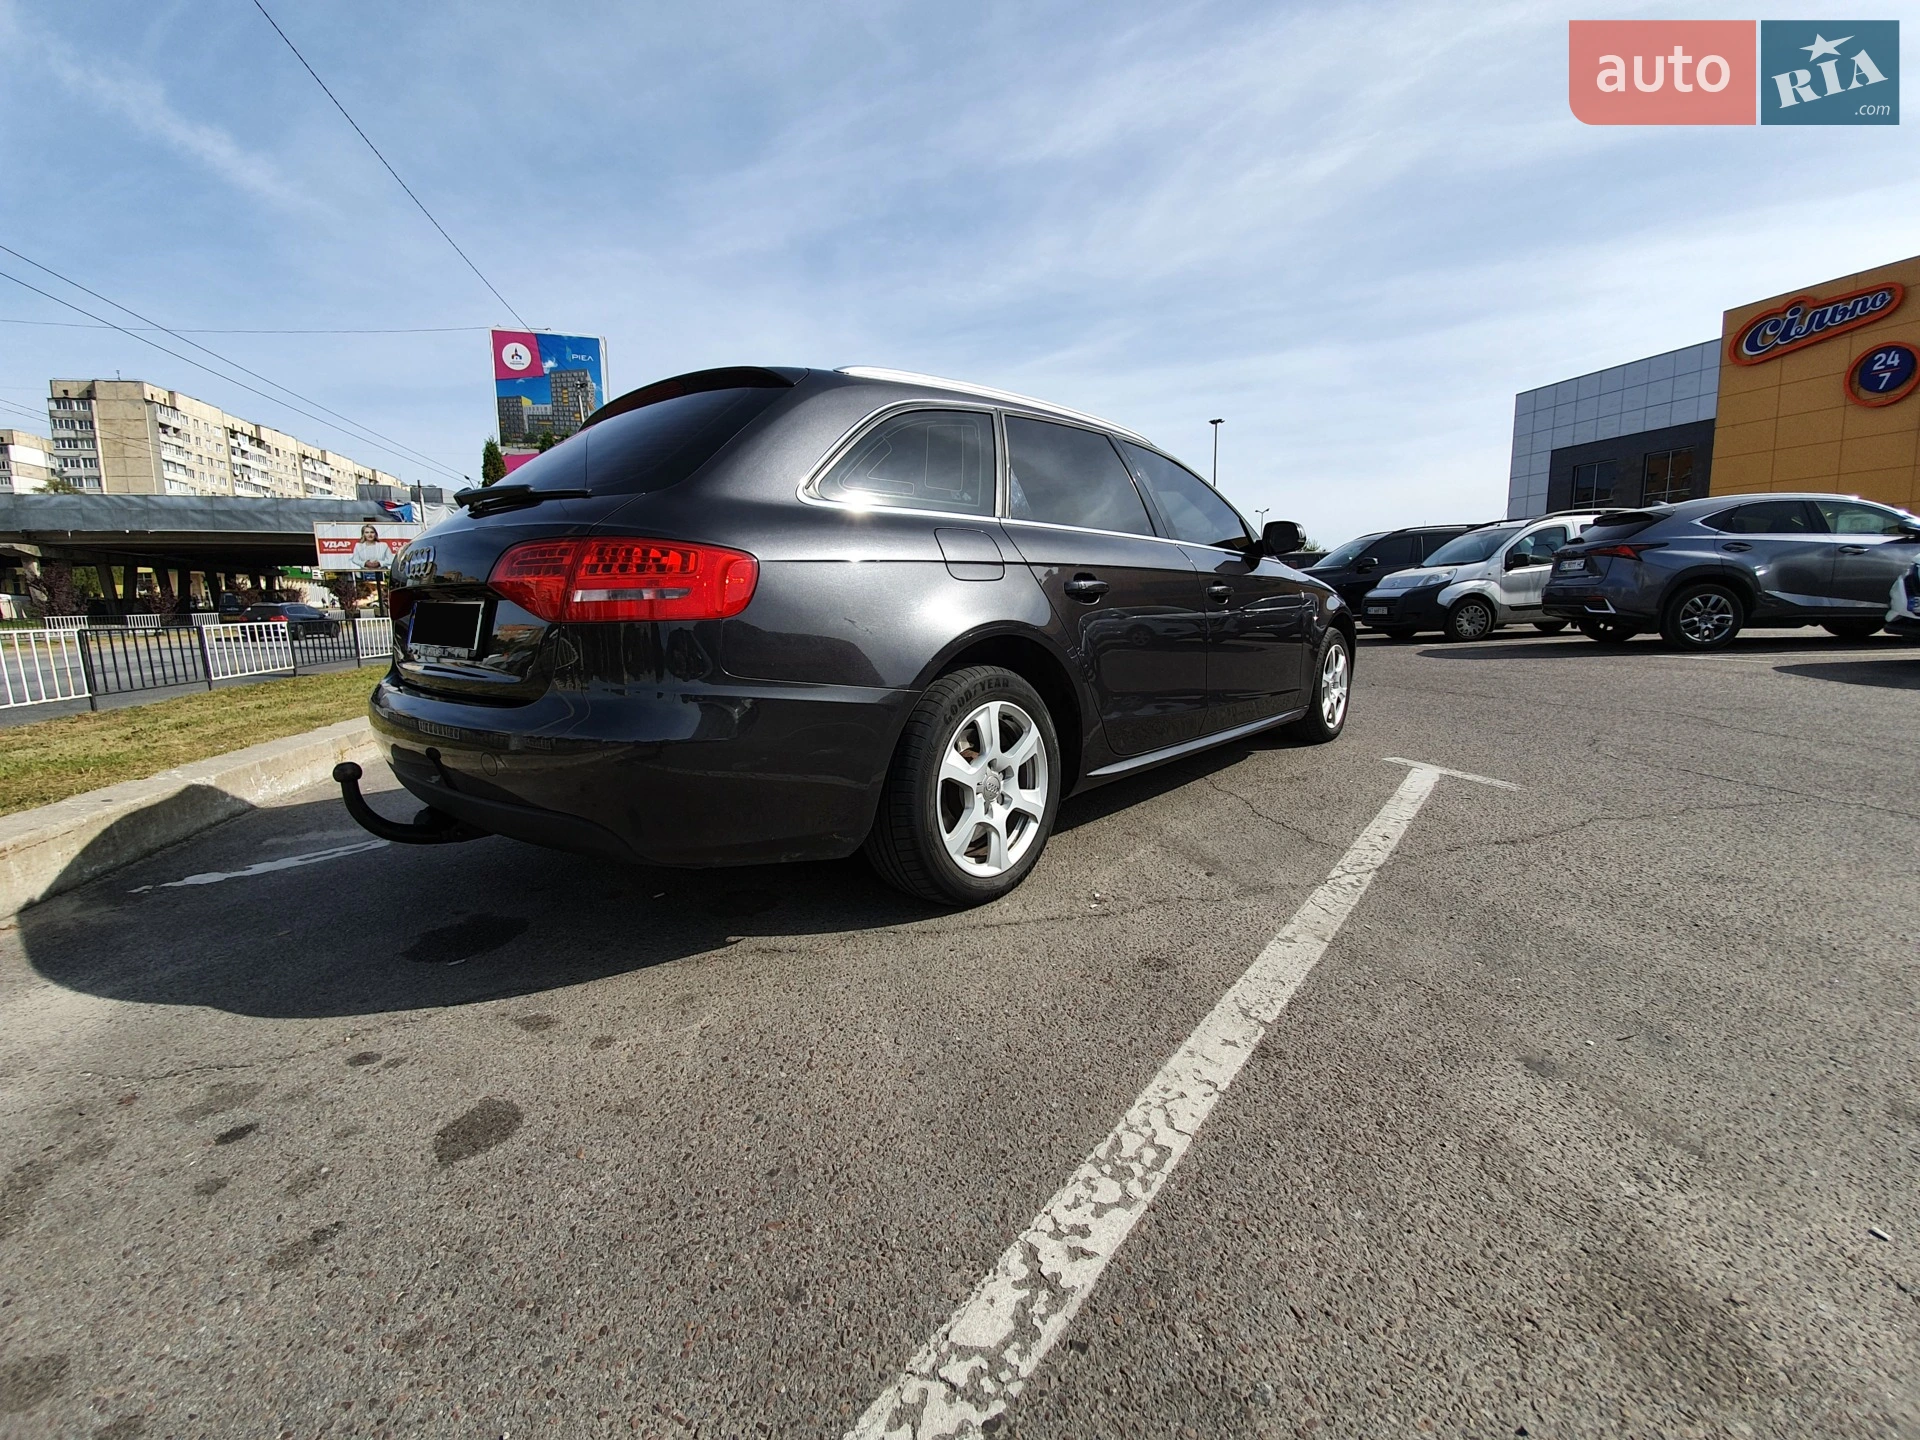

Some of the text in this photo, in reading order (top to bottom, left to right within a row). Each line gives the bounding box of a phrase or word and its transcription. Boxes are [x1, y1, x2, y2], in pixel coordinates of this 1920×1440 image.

[1743, 290, 1892, 355] Сільпо
[1872, 350, 1900, 371] 24
[1878, 372, 1892, 390] 7
[322, 540, 352, 549] УДАР
